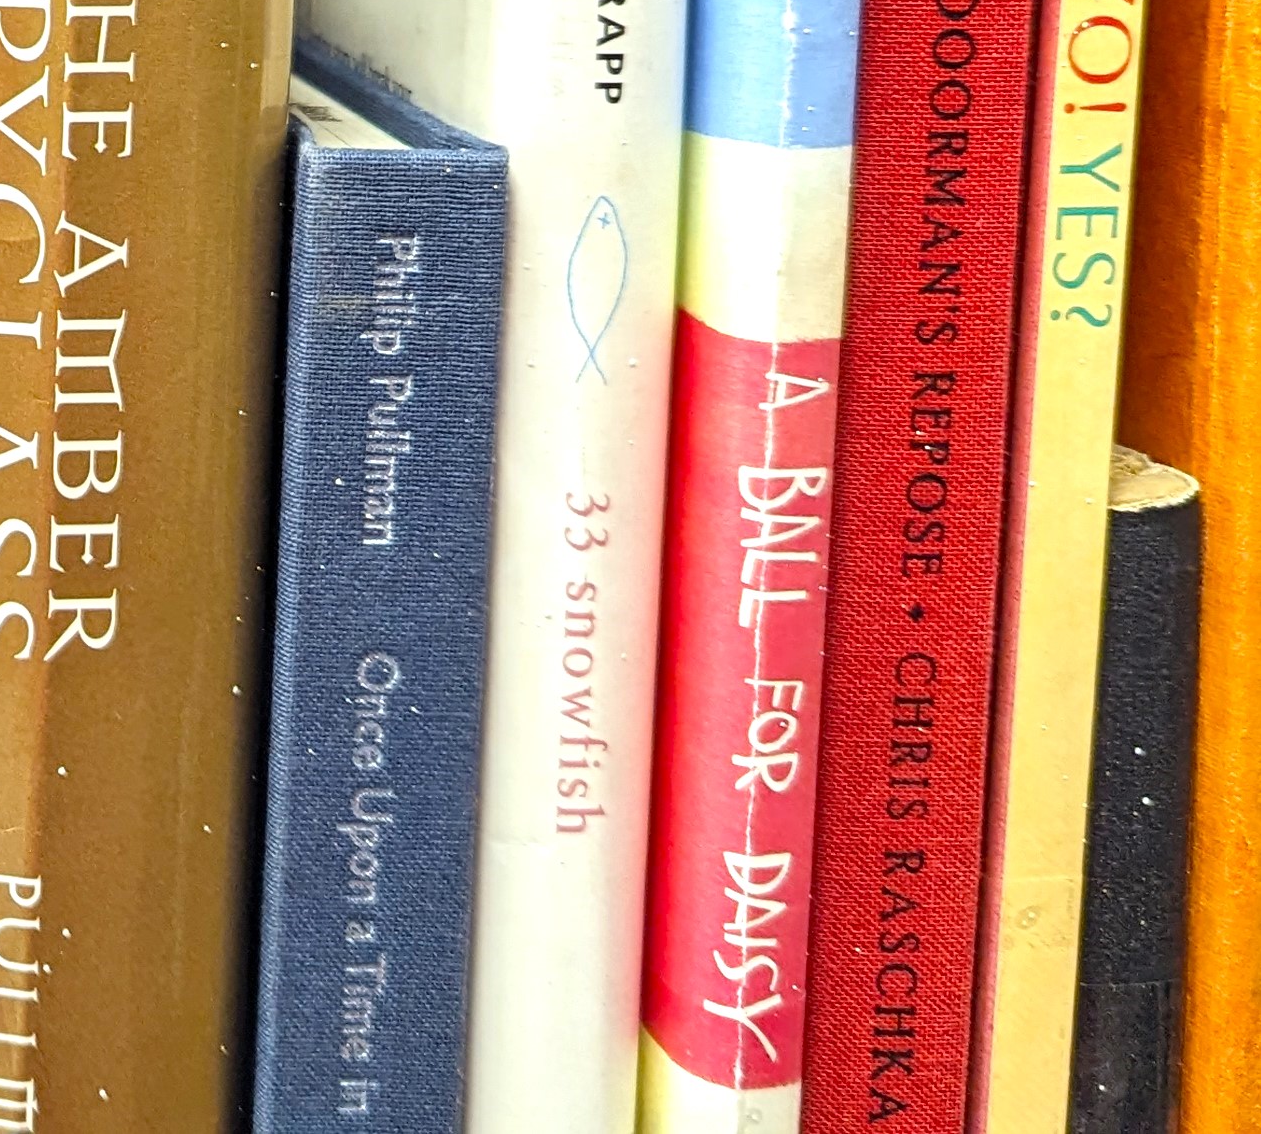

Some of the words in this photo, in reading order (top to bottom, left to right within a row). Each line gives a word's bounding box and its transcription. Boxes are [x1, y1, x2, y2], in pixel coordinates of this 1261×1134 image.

[360, 232, 419, 356] Philip
[1050, 142, 1124, 329] YES?
[42, 209, 129, 663] AMBER
[362, 373, 414, 546] Pullman
[758, 372, 830, 414] A
[564, 492, 611, 552] 33
[738, 465, 828, 629] BALL
[902, 371, 957, 579] REPOSE
[352, 651, 400, 769] Once
[555, 580, 608, 834] snowfish
[730, 677, 806, 794] FOR
[887, 651, 938, 820] CHRIS
[337, 787, 398, 904] Upon
[344, 918, 376, 944] a
[702, 851, 792, 1064] DAISY
[868, 849, 926, 1124] RASCHKA
[340, 951, 387, 1061] Time
[338, 1079, 380, 1113] in
